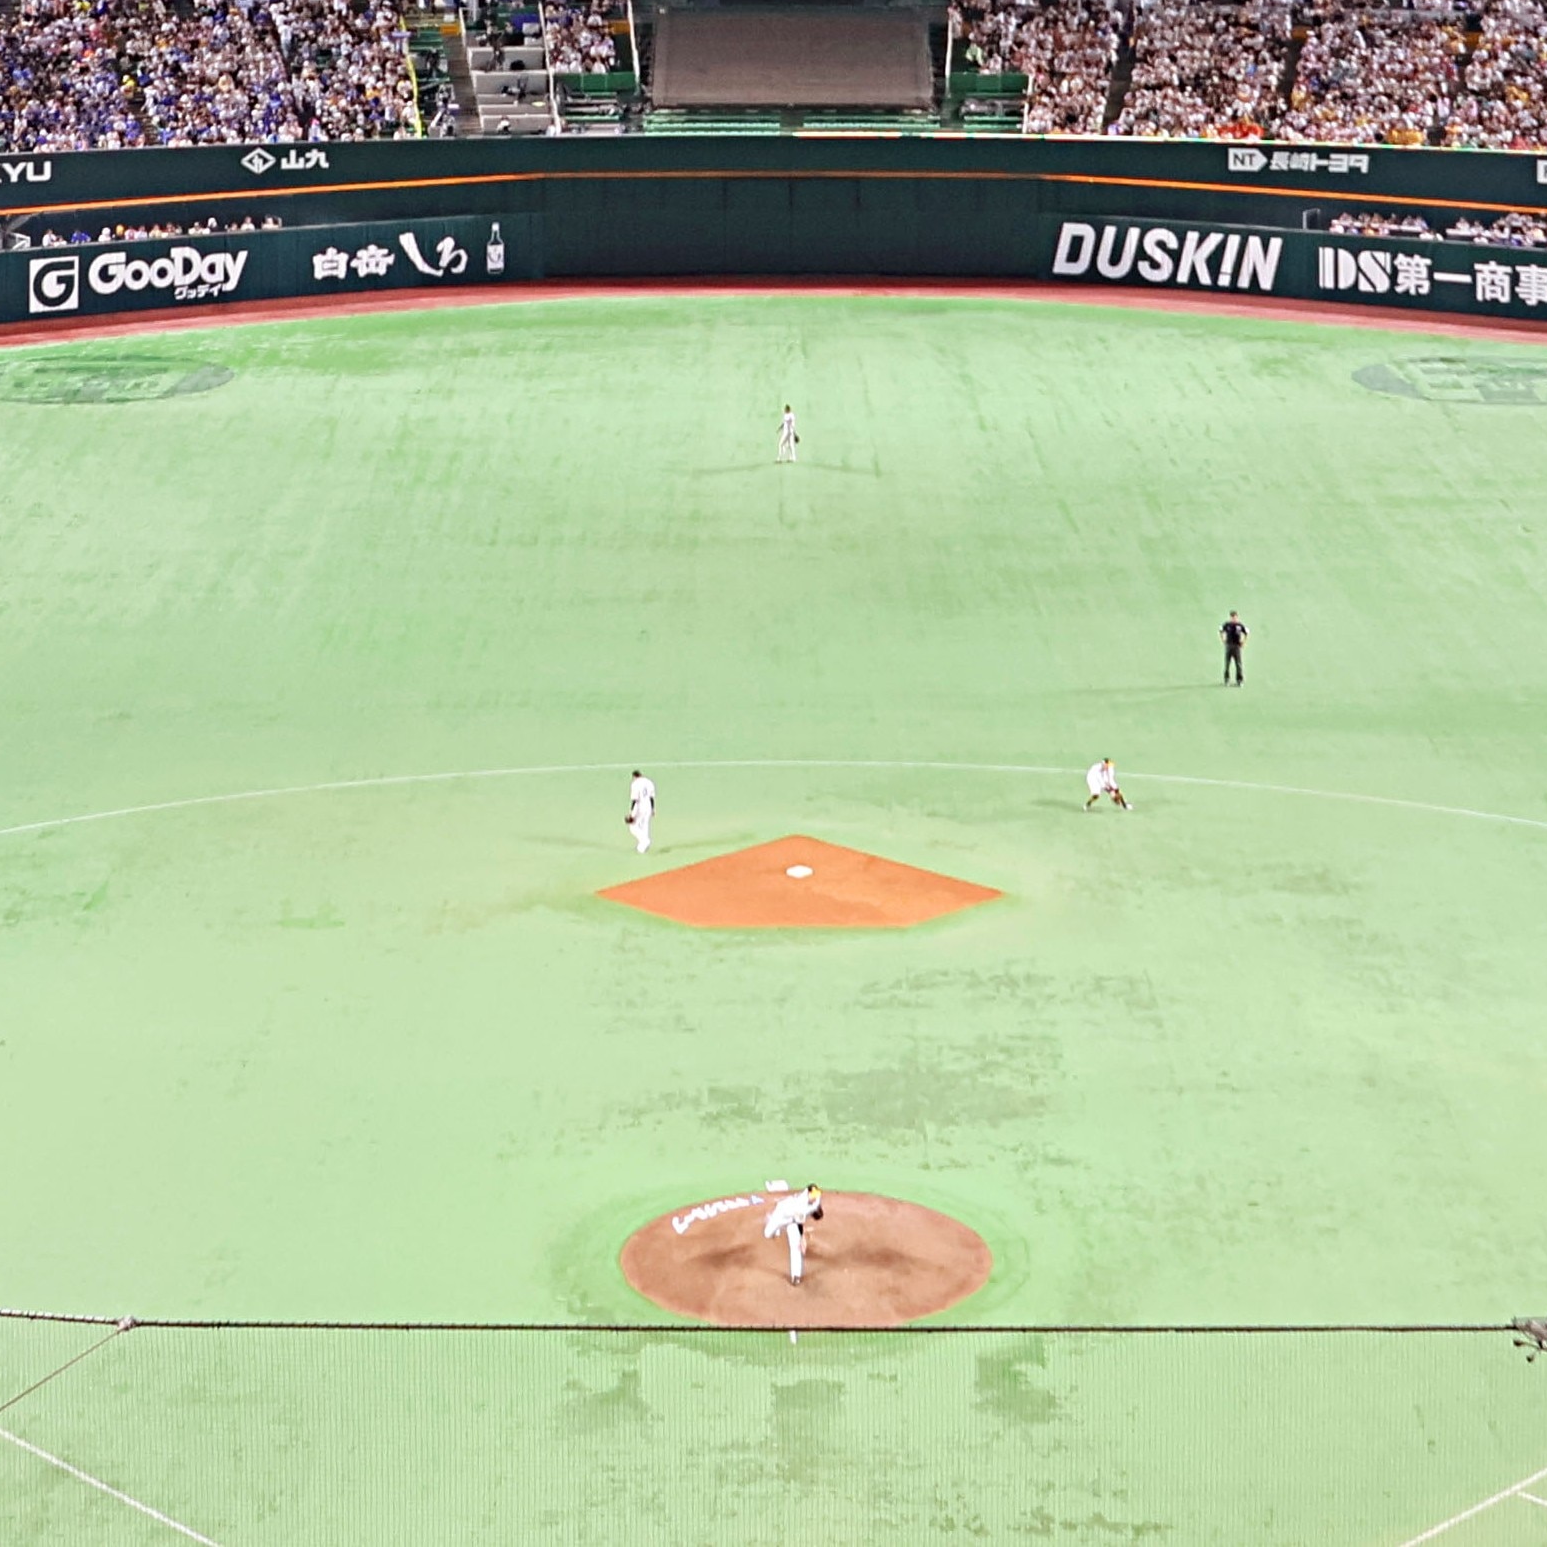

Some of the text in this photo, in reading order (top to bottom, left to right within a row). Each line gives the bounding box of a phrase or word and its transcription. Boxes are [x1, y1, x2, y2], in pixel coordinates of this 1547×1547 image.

[281, 149, 330, 170] 山九
[88, 246, 249, 295] GooDay
[1052, 221, 1283, 292] DUSKIN
[174, 284, 223, 301] グッデイ
